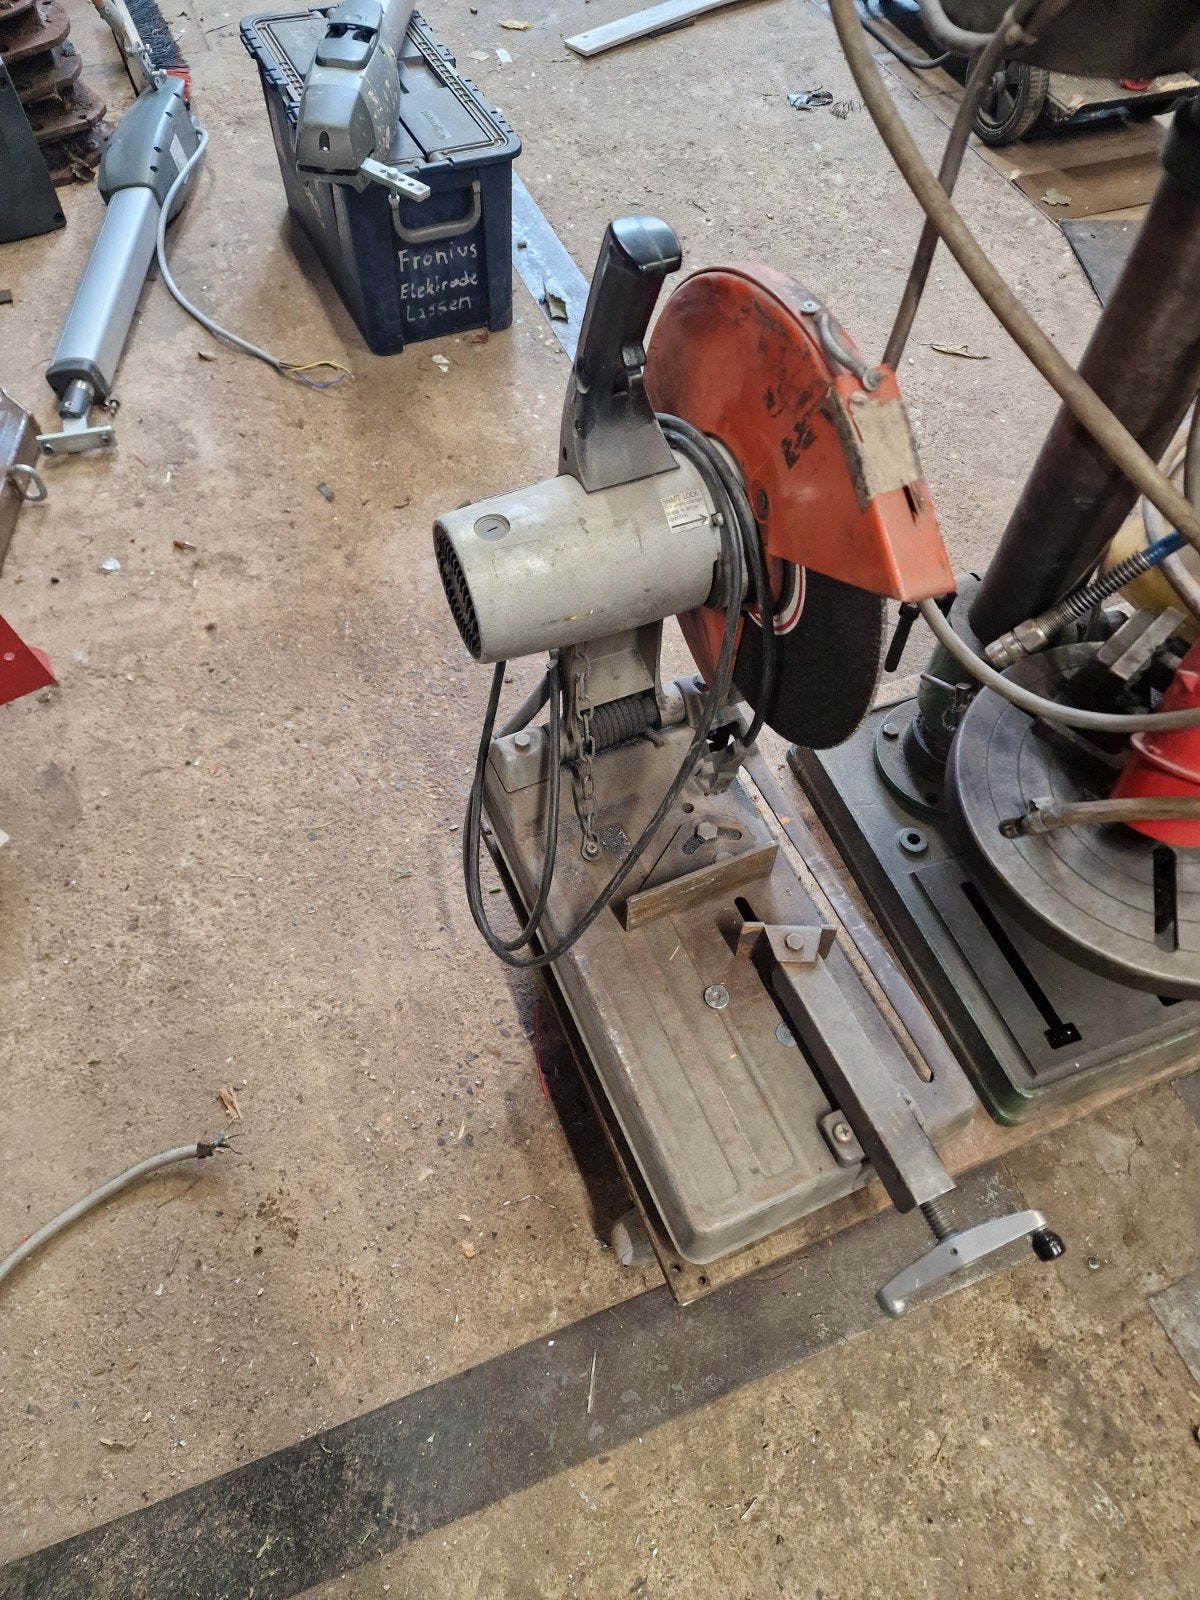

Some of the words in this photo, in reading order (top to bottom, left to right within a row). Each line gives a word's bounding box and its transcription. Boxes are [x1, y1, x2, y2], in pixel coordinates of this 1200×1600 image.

[398, 241, 477, 272] Fronius
[406, 296, 472, 322] Lassen
[662, 494, 680, 504] SHAFT
[682, 490, 699, 500] LOCK
